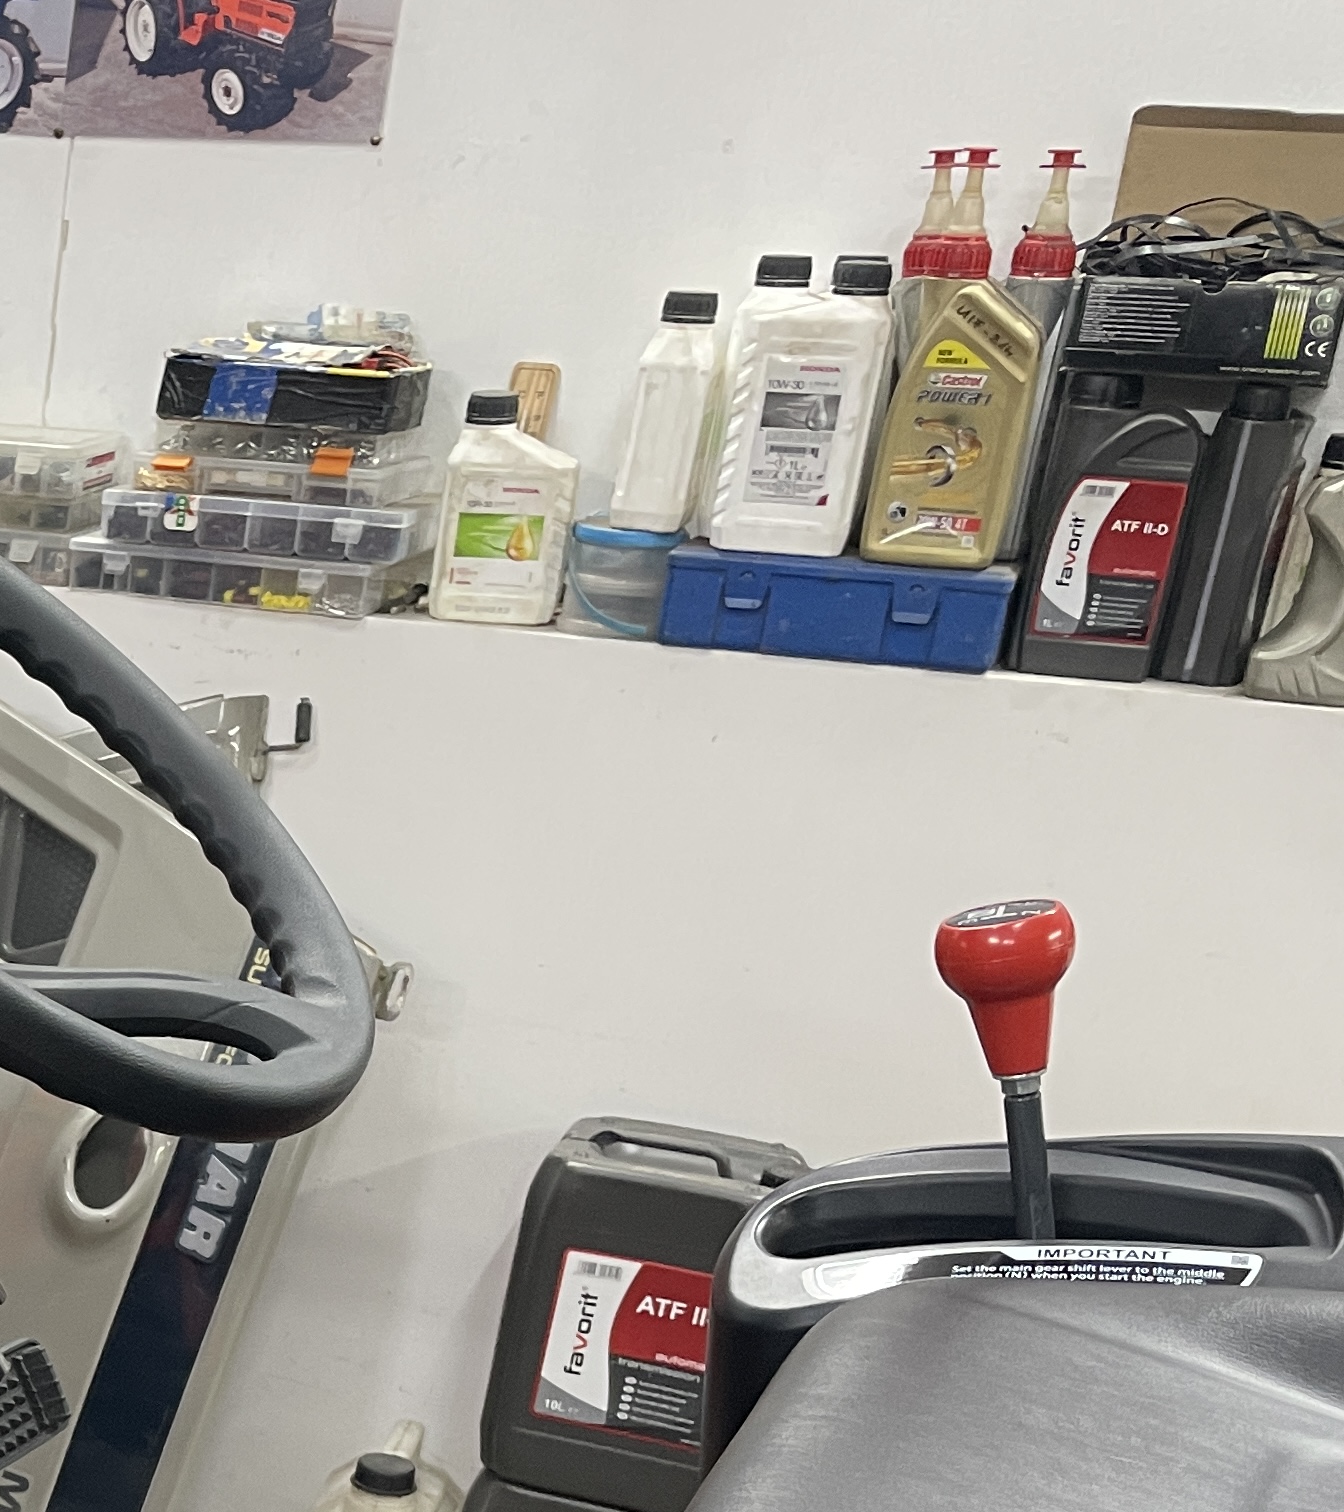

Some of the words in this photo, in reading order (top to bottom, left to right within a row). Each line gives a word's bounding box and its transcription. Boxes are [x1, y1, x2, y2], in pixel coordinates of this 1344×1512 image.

[942, 375, 983, 387] Castrol
[1110, 519, 1142, 534] ATF
[1142, 521, 1170, 537] II-D
[1055, 516, 1086, 588] favorit
[1037, 1248, 1172, 1260] IMPORTANT
[951, 1264, 973, 1273] Set
[974, 1264, 998, 1273] the
[998, 1264, 1033, 1273] main
[1034, 1265, 1066, 1275] gear
[1066, 1263, 1097, 1273] shift
[1098, 1264, 1133, 1274] lever
[1134, 1266, 1150, 1275] to
[1152, 1266, 1175, 1276] the
[1176, 1267, 1226, 1280] middle
[1030, 1272, 1068, 1280] when
[1069, 1273, 1096, 1282] you
[1097, 1273, 1130, 1282] start
[1131, 1273, 1155, 1282] the
[635, 1294, 688, 1321] ATF
[563, 1289, 599, 1376] favorit
